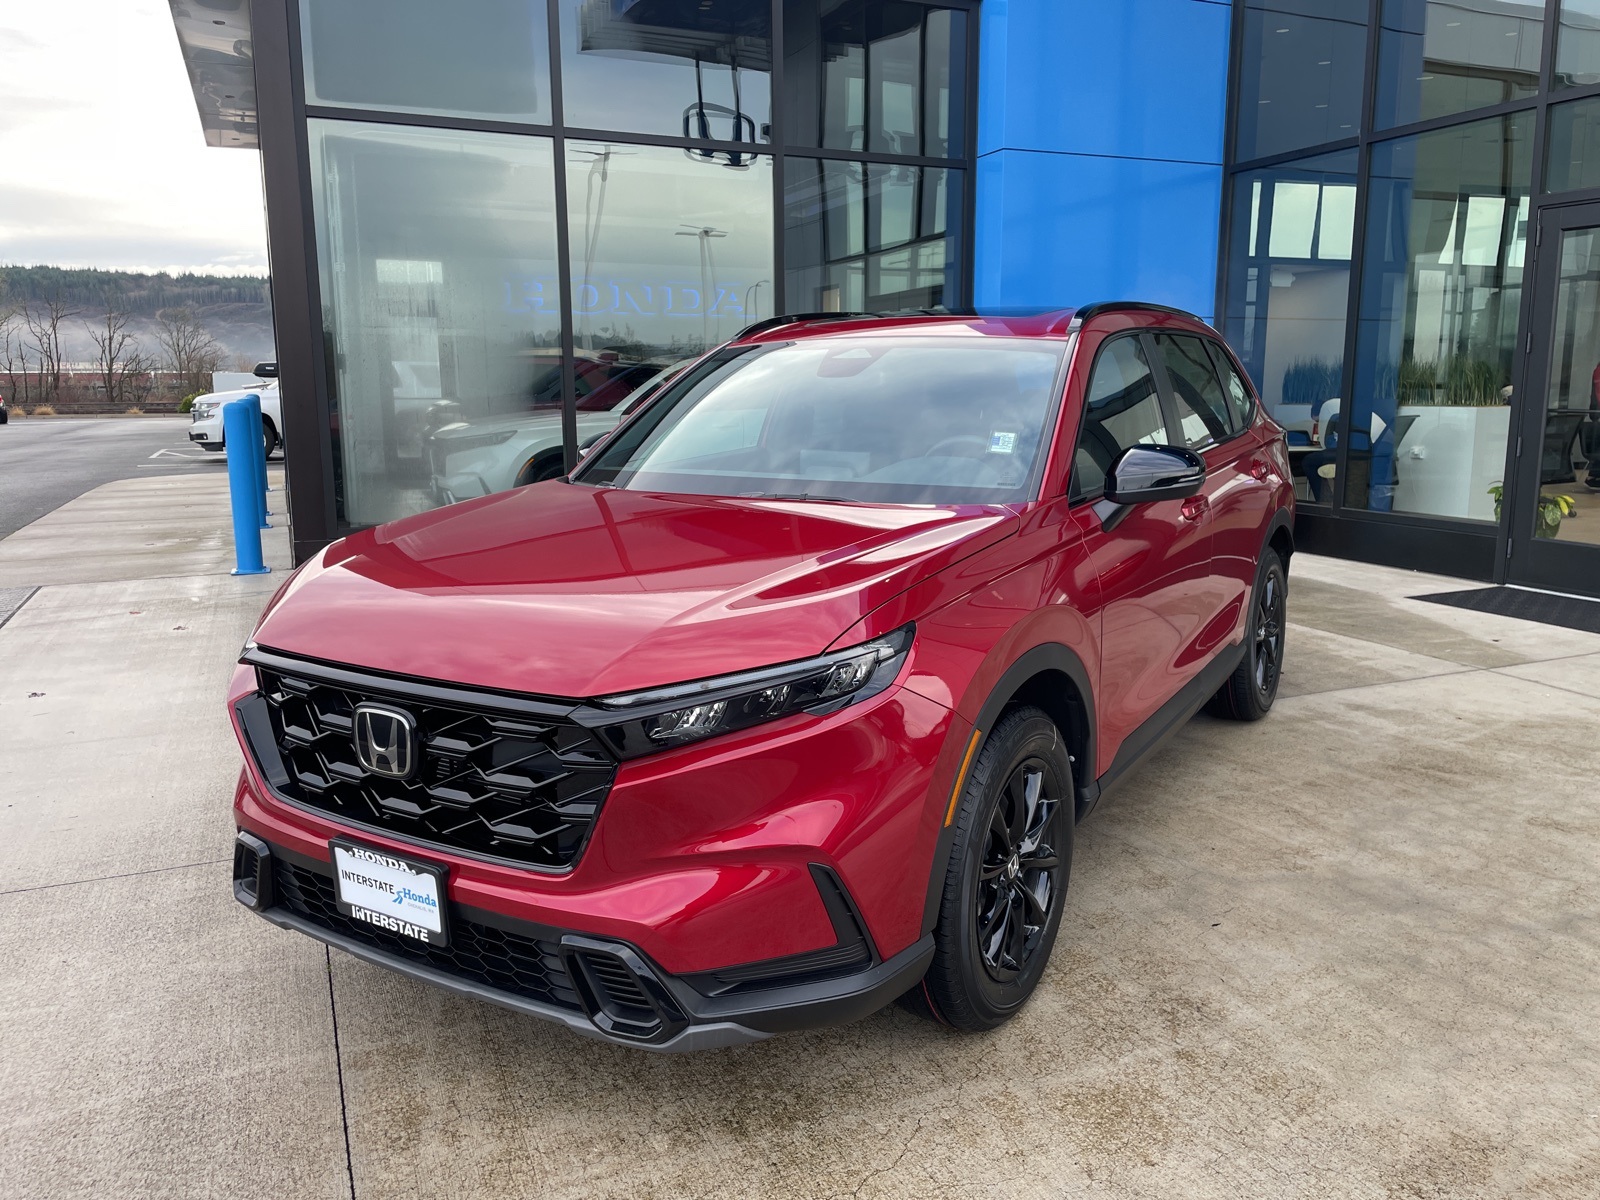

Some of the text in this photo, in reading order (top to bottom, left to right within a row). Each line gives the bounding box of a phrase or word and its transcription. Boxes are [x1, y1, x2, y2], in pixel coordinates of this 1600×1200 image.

[503, 276, 759, 318] HONDA
[352, 847, 411, 873] HONDA
[341, 869, 437, 907] INTERSTATE Honda
[351, 905, 429, 943] INTERSTATE
